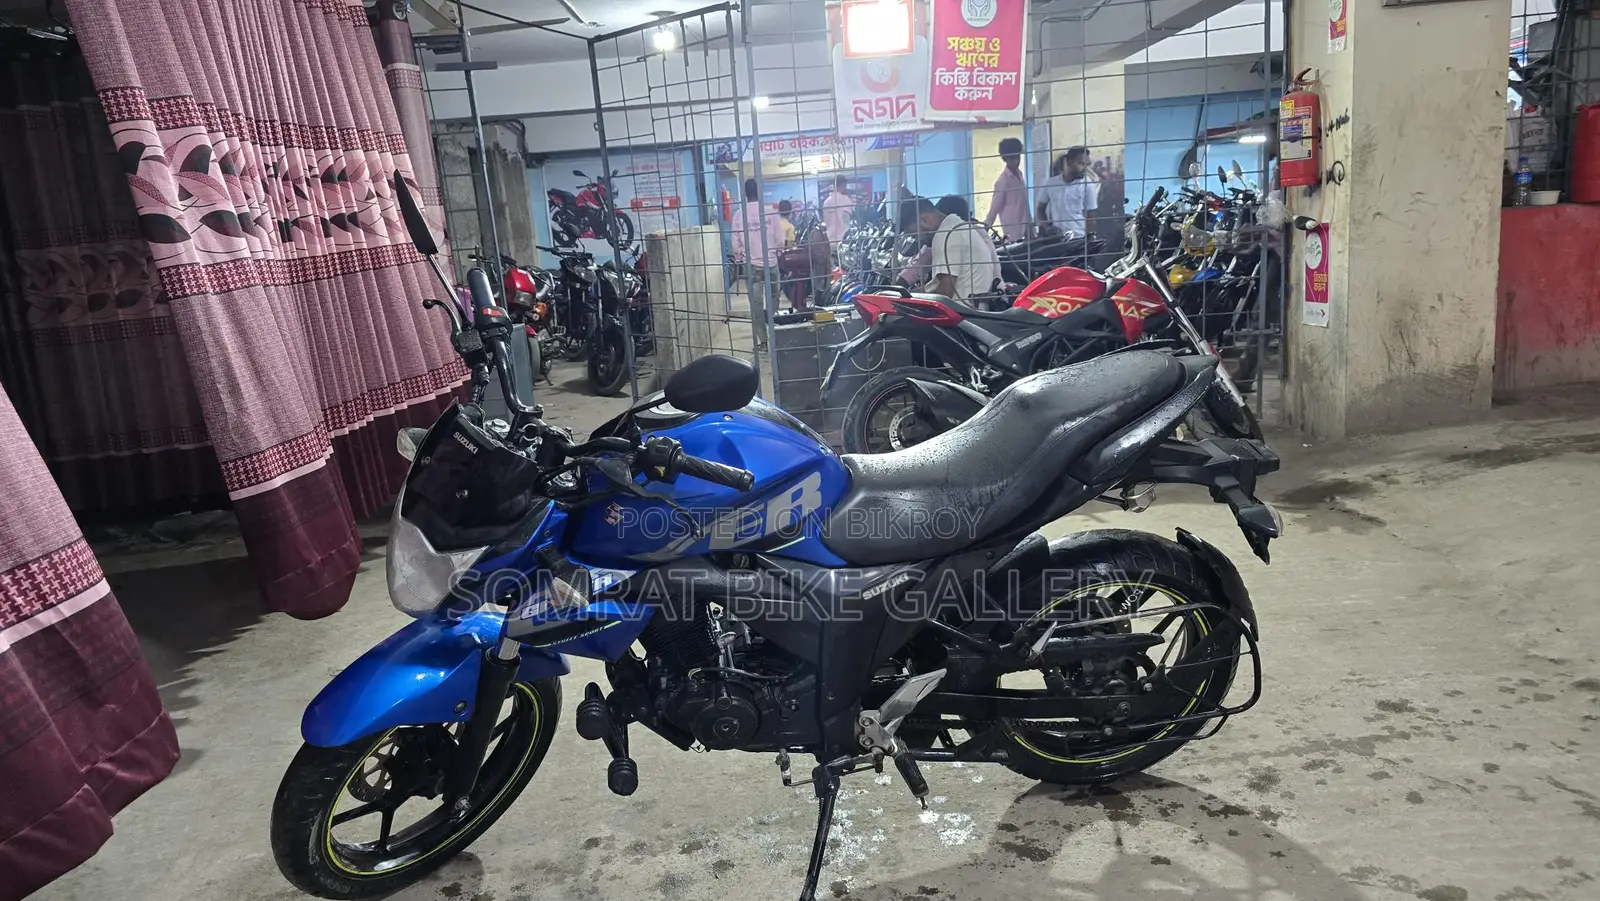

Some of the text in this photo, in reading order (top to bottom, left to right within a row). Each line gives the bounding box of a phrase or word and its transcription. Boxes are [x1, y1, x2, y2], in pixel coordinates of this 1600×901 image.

[947, 36, 1001, 53] সঞ্চয় ও
[955, 52, 1000, 68] ঋণের
[934, 67, 1018, 86] কিস্তি বিকাশ
[954, 86, 994, 101] করুন
[852, 94, 917, 123] নগদ
[453, 431, 479, 455] SUZUKI
[862, 571, 910, 601] SUZUKI
